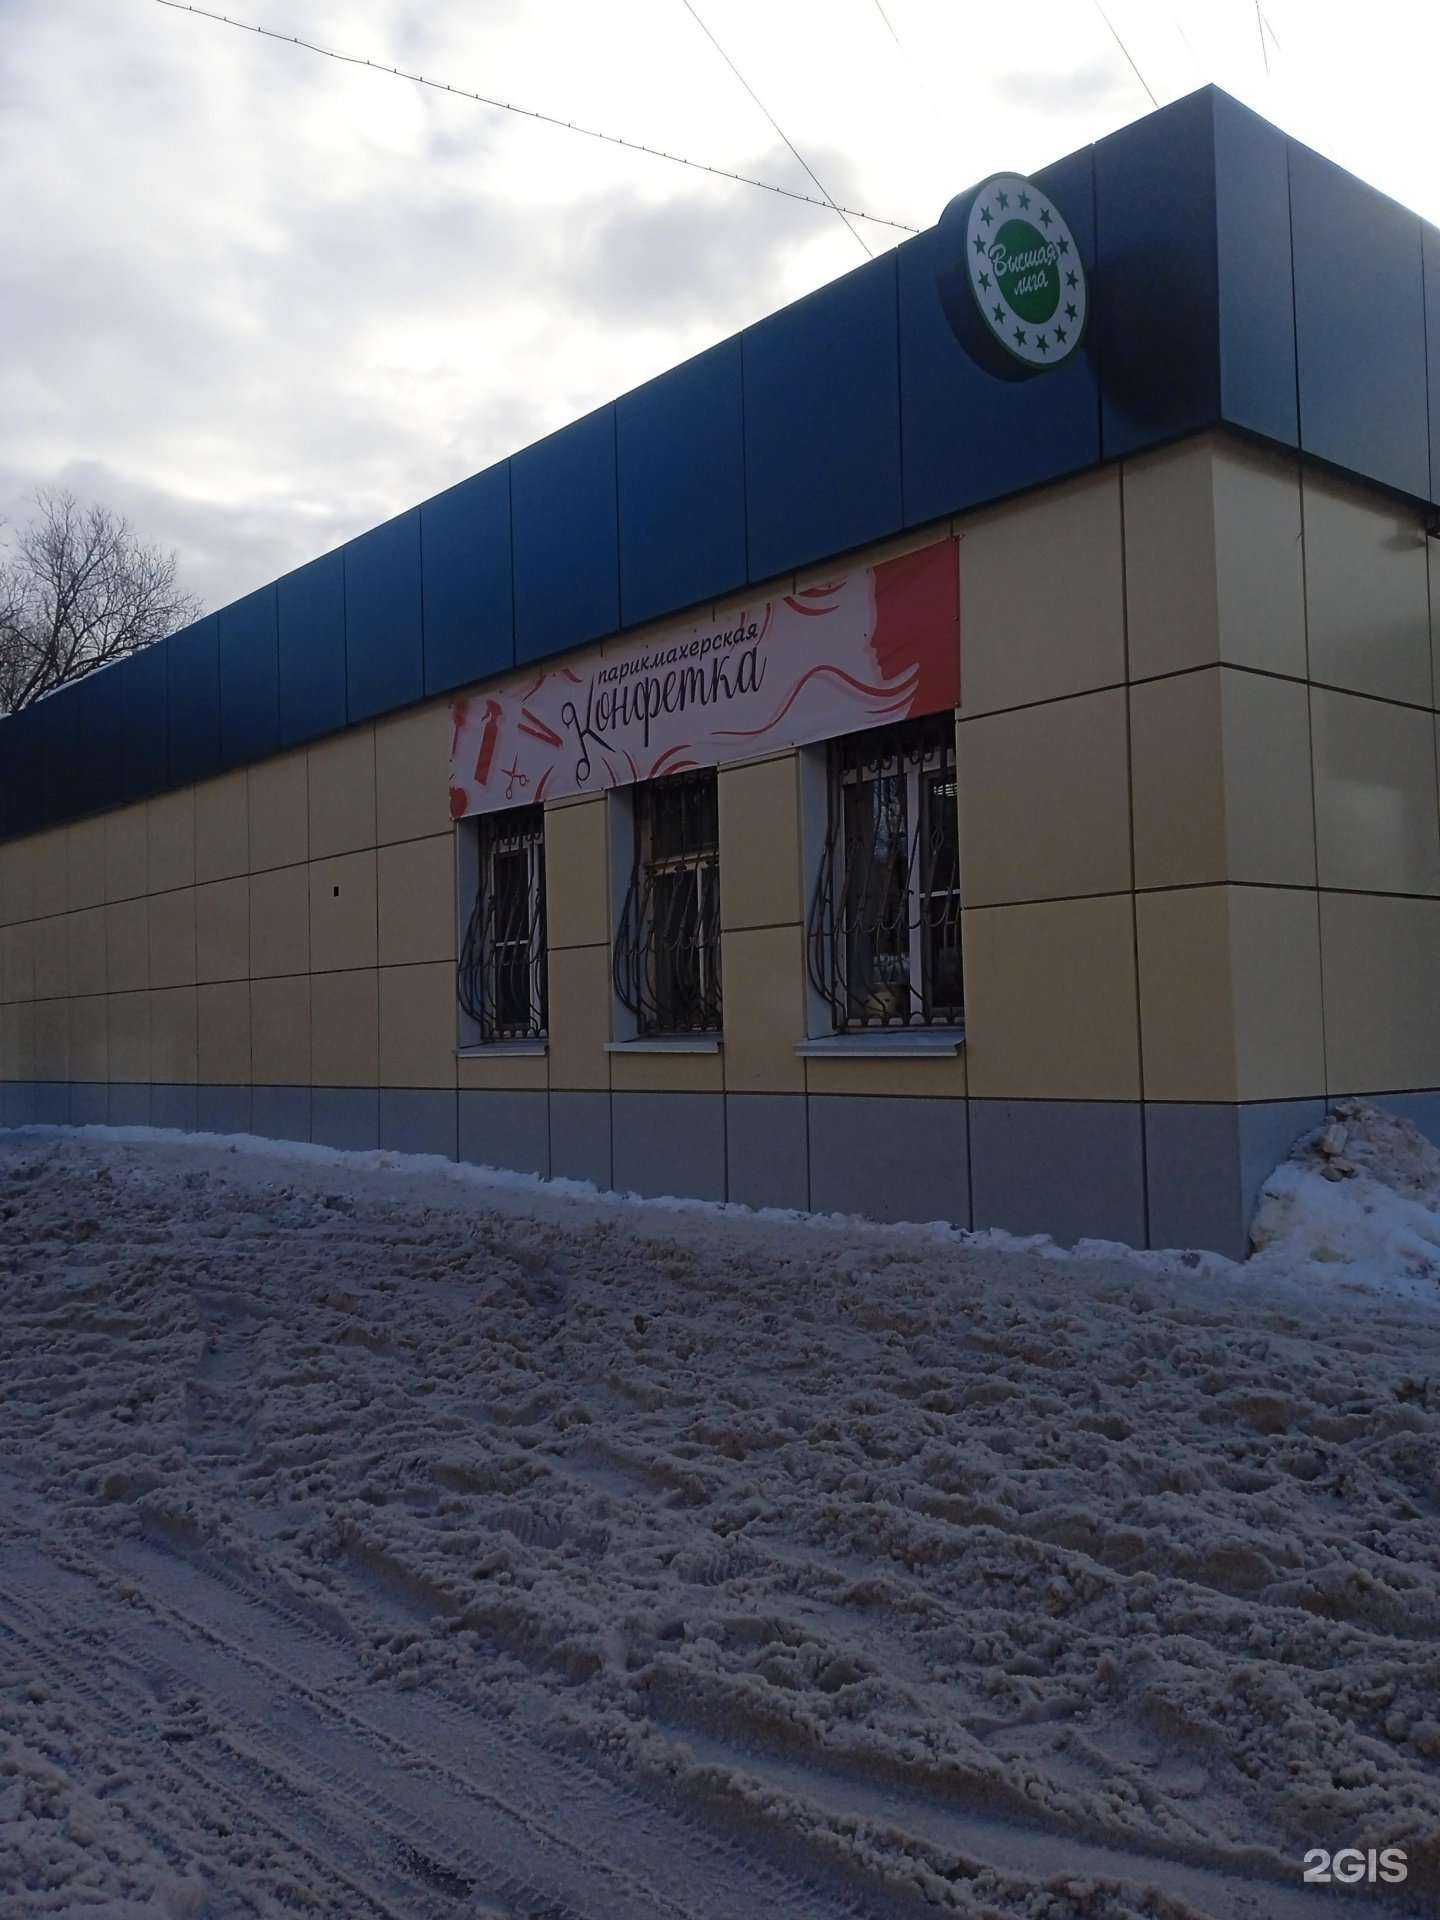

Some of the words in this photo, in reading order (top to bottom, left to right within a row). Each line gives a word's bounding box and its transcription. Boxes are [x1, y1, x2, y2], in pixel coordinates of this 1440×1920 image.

[990, 243, 1059, 277] Высшая
[1014, 270, 1049, 296] лига
[598, 623, 759, 685] парикмахерская
[561, 647, 768, 789] Конфетка
